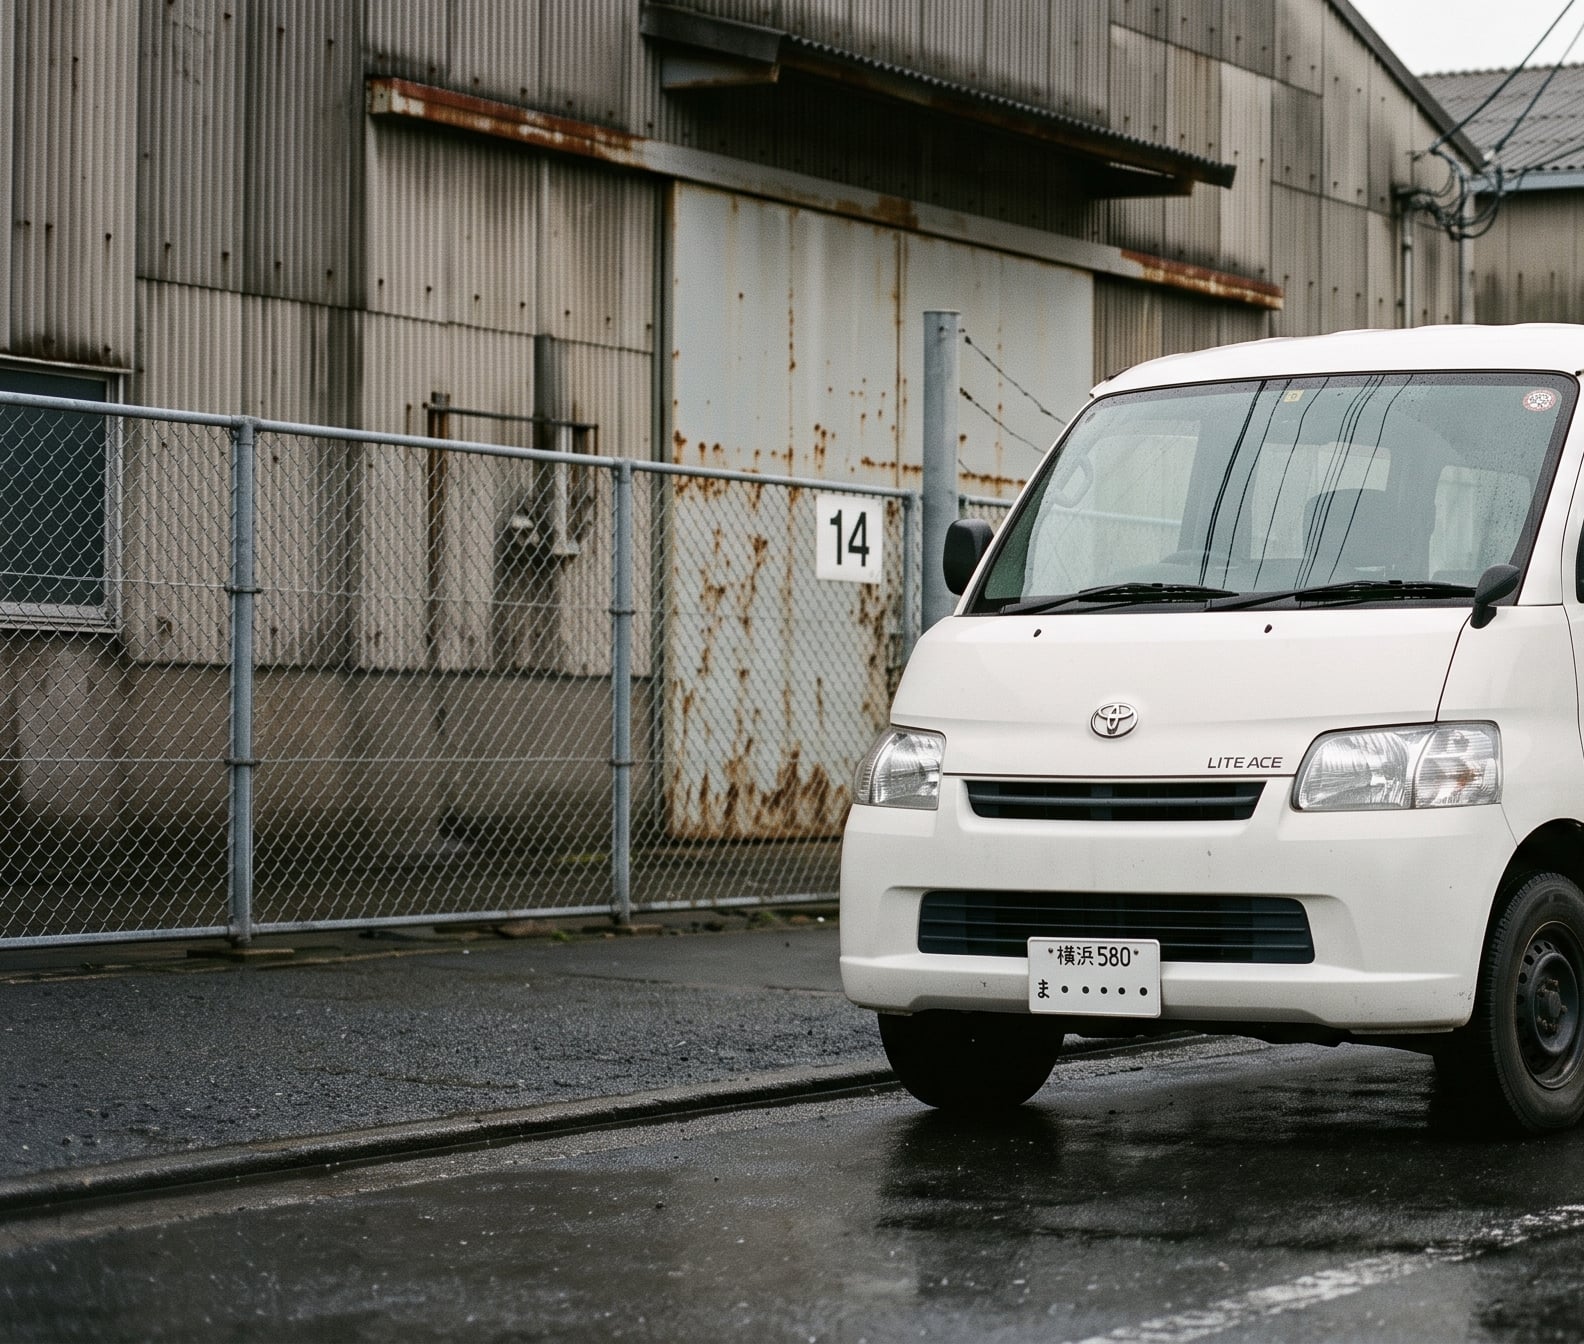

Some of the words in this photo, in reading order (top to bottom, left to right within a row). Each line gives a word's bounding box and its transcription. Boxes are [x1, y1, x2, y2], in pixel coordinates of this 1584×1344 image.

[829, 508, 870, 568] 14
[1207, 756, 1245, 769] LITE
[1247, 756, 1283, 769] ACE
